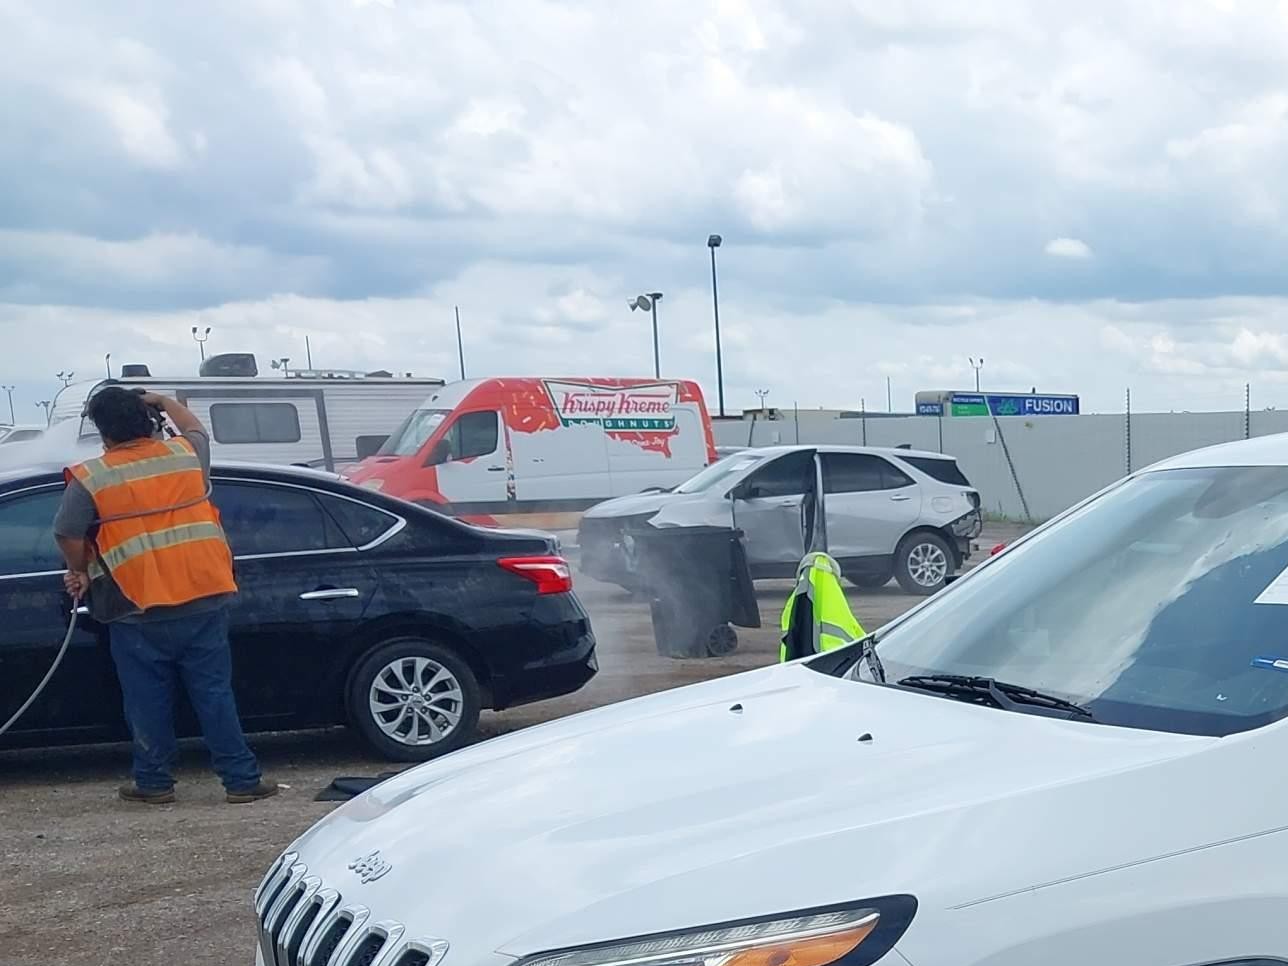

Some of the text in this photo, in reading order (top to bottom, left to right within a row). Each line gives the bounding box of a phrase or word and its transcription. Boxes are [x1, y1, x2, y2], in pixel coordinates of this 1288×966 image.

[562, 391, 671, 417] Krispy Kreme
[1025, 398, 1073, 412] FUSION
